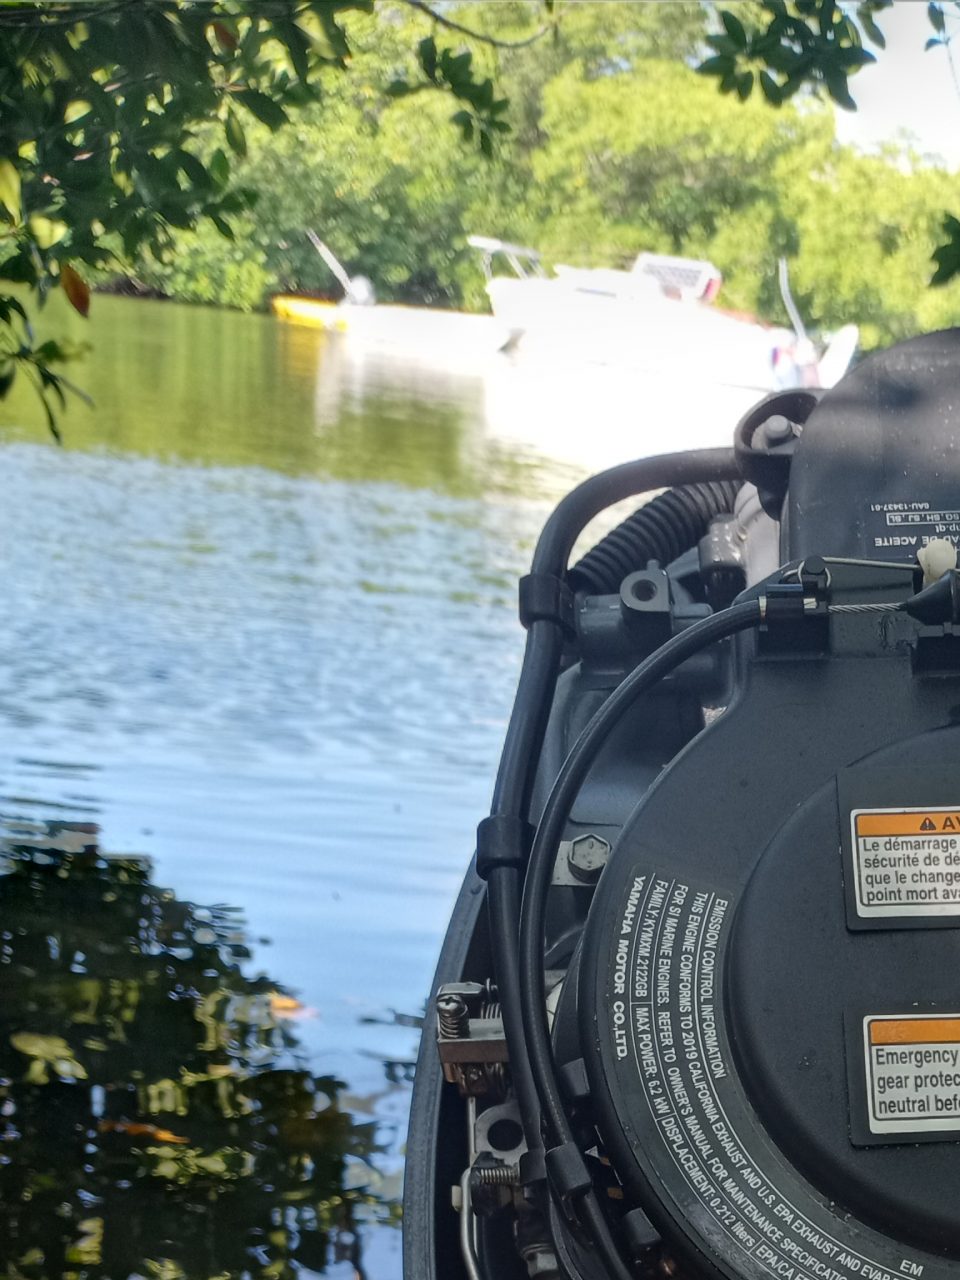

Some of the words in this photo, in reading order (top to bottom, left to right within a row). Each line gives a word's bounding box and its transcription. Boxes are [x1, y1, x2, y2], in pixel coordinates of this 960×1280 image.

[862, 838, 880, 852] Le
[883, 833, 958, 854] démarrage
[864, 853, 919, 869] sécurité
[923, 852, 940, 867] de
[865, 873, 891, 888] que
[894, 870, 907, 885] le
[620, 875, 646, 935] YAMAHA
[671, 884, 689, 905] FOR
[691, 892, 709, 914] THIS
[866, 886, 902, 905] point
[906, 887, 938, 901] mort
[668, 905, 682, 917] SI
[704, 898, 728, 949] EMISSION
[659, 917, 679, 957] MARINE
[682, 914, 701, 953] ENGINE
[614, 939, 630, 994] MOTOR
[700, 950, 716, 1003] CONTROL
[657, 958, 671, 1007] ENGINES.
[679, 954, 693, 1013] CONFORMS
[635, 1007, 651, 1032] MAX
[658, 1011, 674, 1047] REFER
[680, 1014, 693, 1030] TO
[681, 1031, 699, 1060] 2019
[701, 1004, 727, 1079] INFORMATION
[638, 1033, 658, 1078] POWER:
[663, 1047, 677, 1063] TO
[875, 1048, 959, 1069] Emergency
[648, 1080, 663, 1096] 6.2
[667, 1067, 693, 1116] OWNER'S
[688, 1061, 720, 1124] CALIFORNIA
[877, 1075, 910, 1094] gear
[653, 1096, 671, 1114] kW
[878, 1095, 930, 1114] neutral
[684, 1115, 714, 1160] MANUAL
[711, 1121, 748, 1168] EXHAUST
[661, 1117, 716, 1200] DISPLACEMENT:
[707, 1157, 729, 1181] FOR
[739, 1167, 762, 1189] AND
[757, 1185, 776, 1208] U.S.
[709, 1197, 736, 1226] 0.212
[722, 1178, 784, 1243] MAINTENANCE
[773, 1203, 795, 1225] EPA
[731, 1221, 756, 1247] liters
[791, 1219, 840, 1258] EXHAUST
[755, 1244, 795, 1280] EPA/CA
[835, 1252, 861, 1271] AND
[899, 1259, 924, 1277] EM
